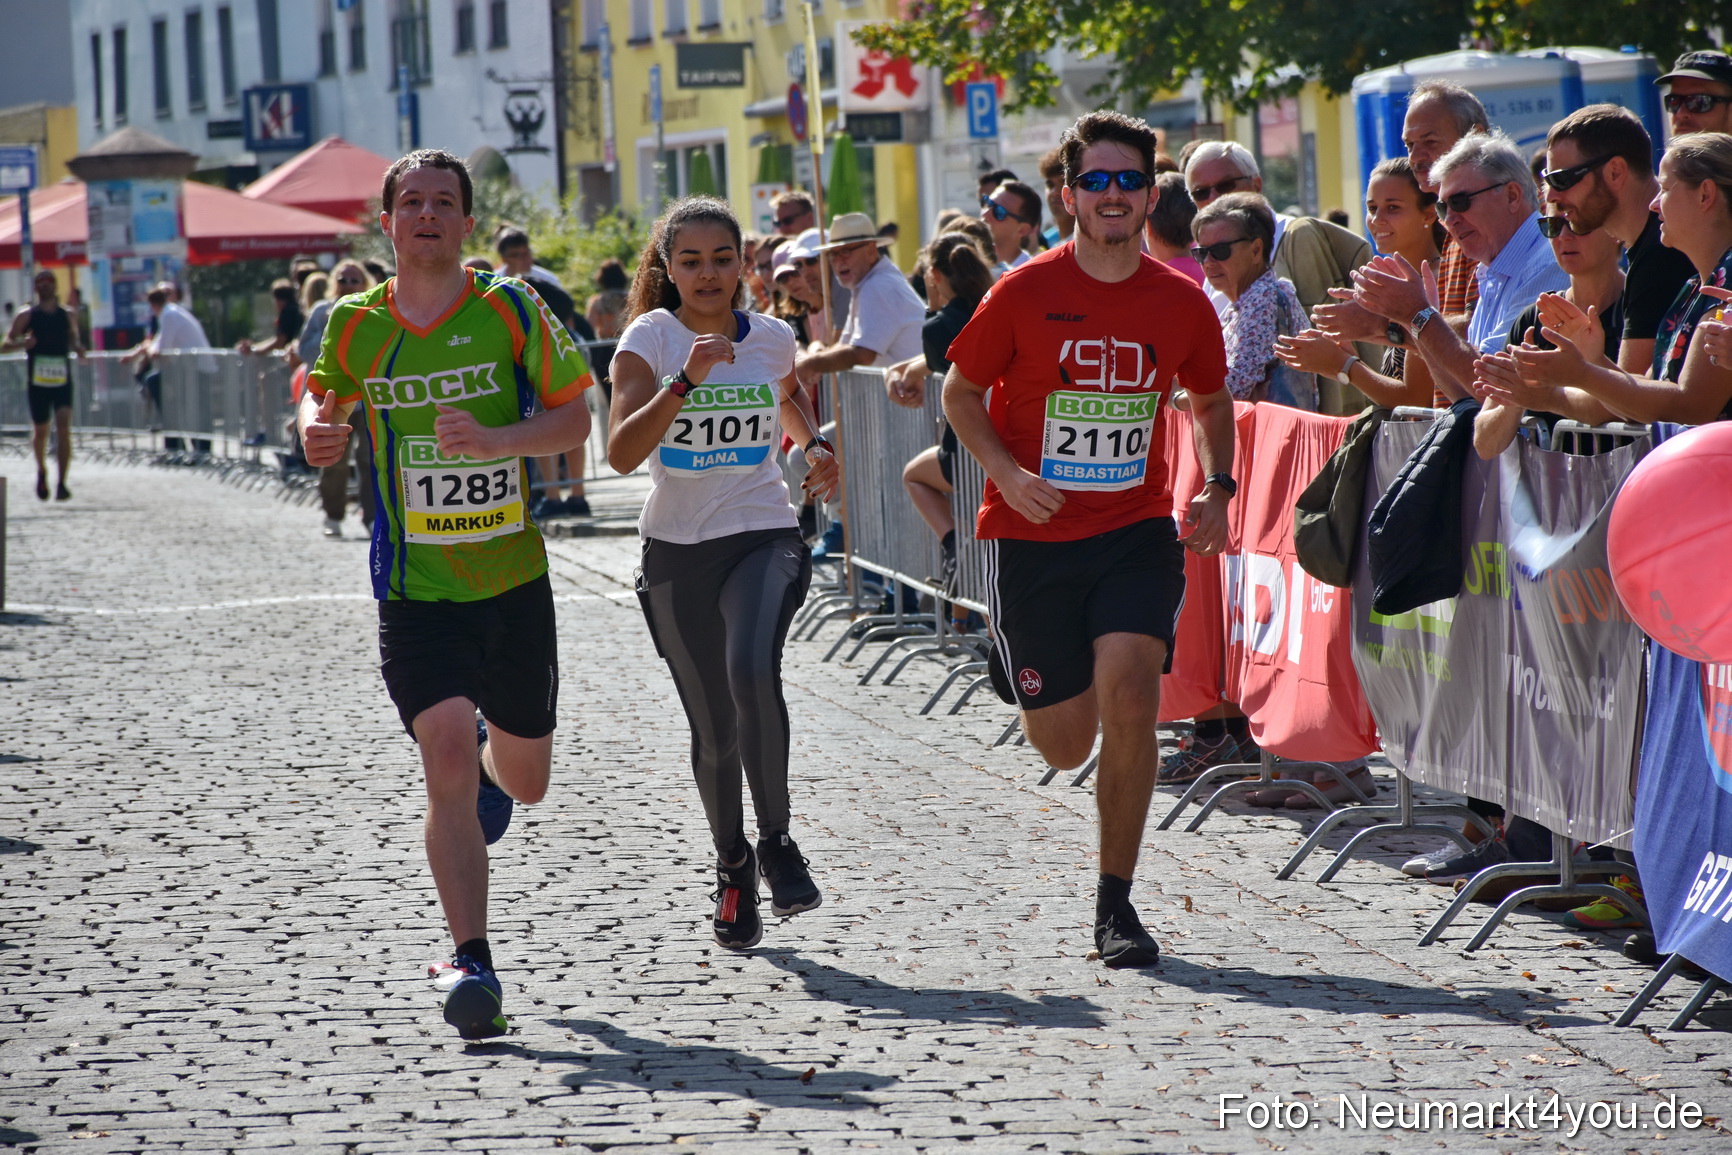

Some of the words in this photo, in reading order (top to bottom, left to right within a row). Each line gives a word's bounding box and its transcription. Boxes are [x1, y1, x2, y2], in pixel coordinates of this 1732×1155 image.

[680, 69, 742, 83] TAIFUN
[972, 90, 992, 133] P
[364, 362, 501, 410] BOCK
[1055, 394, 1151, 420] BOCK
[673, 414, 760, 446] 2101
[1056, 426, 1143, 458] 2110
[692, 451, 738, 468] HANA
[1052, 463, 1138, 479] SEBASTIAN
[416, 468, 508, 507] 1283
[426, 511, 505, 532] MARKUS
[1021, 678, 1041, 691] FCN
